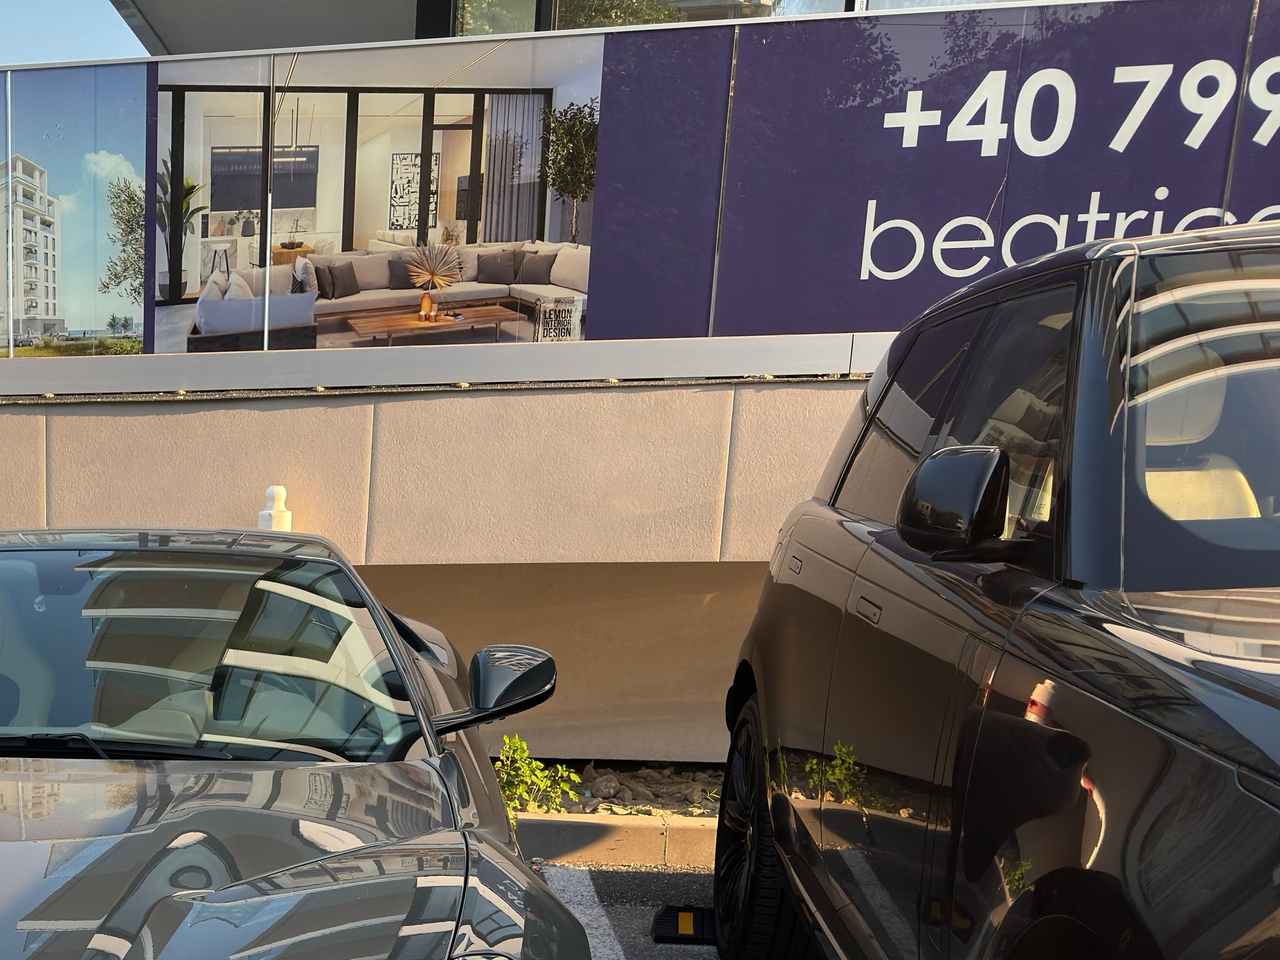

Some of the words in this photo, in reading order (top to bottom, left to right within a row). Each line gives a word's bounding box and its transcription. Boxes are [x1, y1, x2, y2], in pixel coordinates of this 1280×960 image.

[883, 68, 1077, 157] +40
[544, 308, 573, 320] LEMON
[543, 319, 572, 328] INTERIOR
[542, 327, 572, 338] DESIGN
